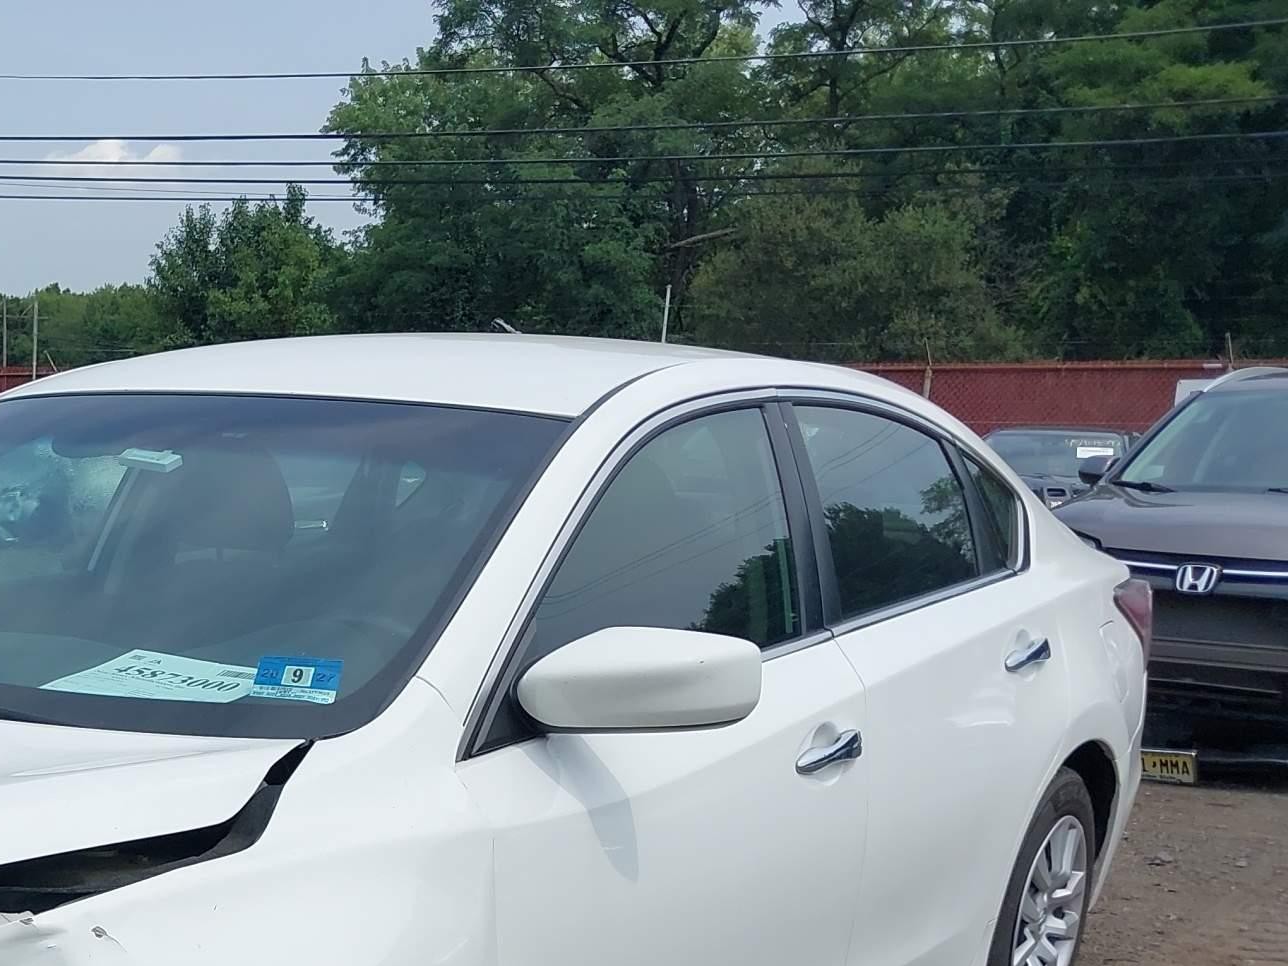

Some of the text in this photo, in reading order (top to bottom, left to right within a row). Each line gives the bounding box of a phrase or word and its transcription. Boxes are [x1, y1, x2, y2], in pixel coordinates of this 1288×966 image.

[114, 665, 241, 692] 45873000
[291, 668, 304, 683] 9
[316, 672, 337, 682] 27
